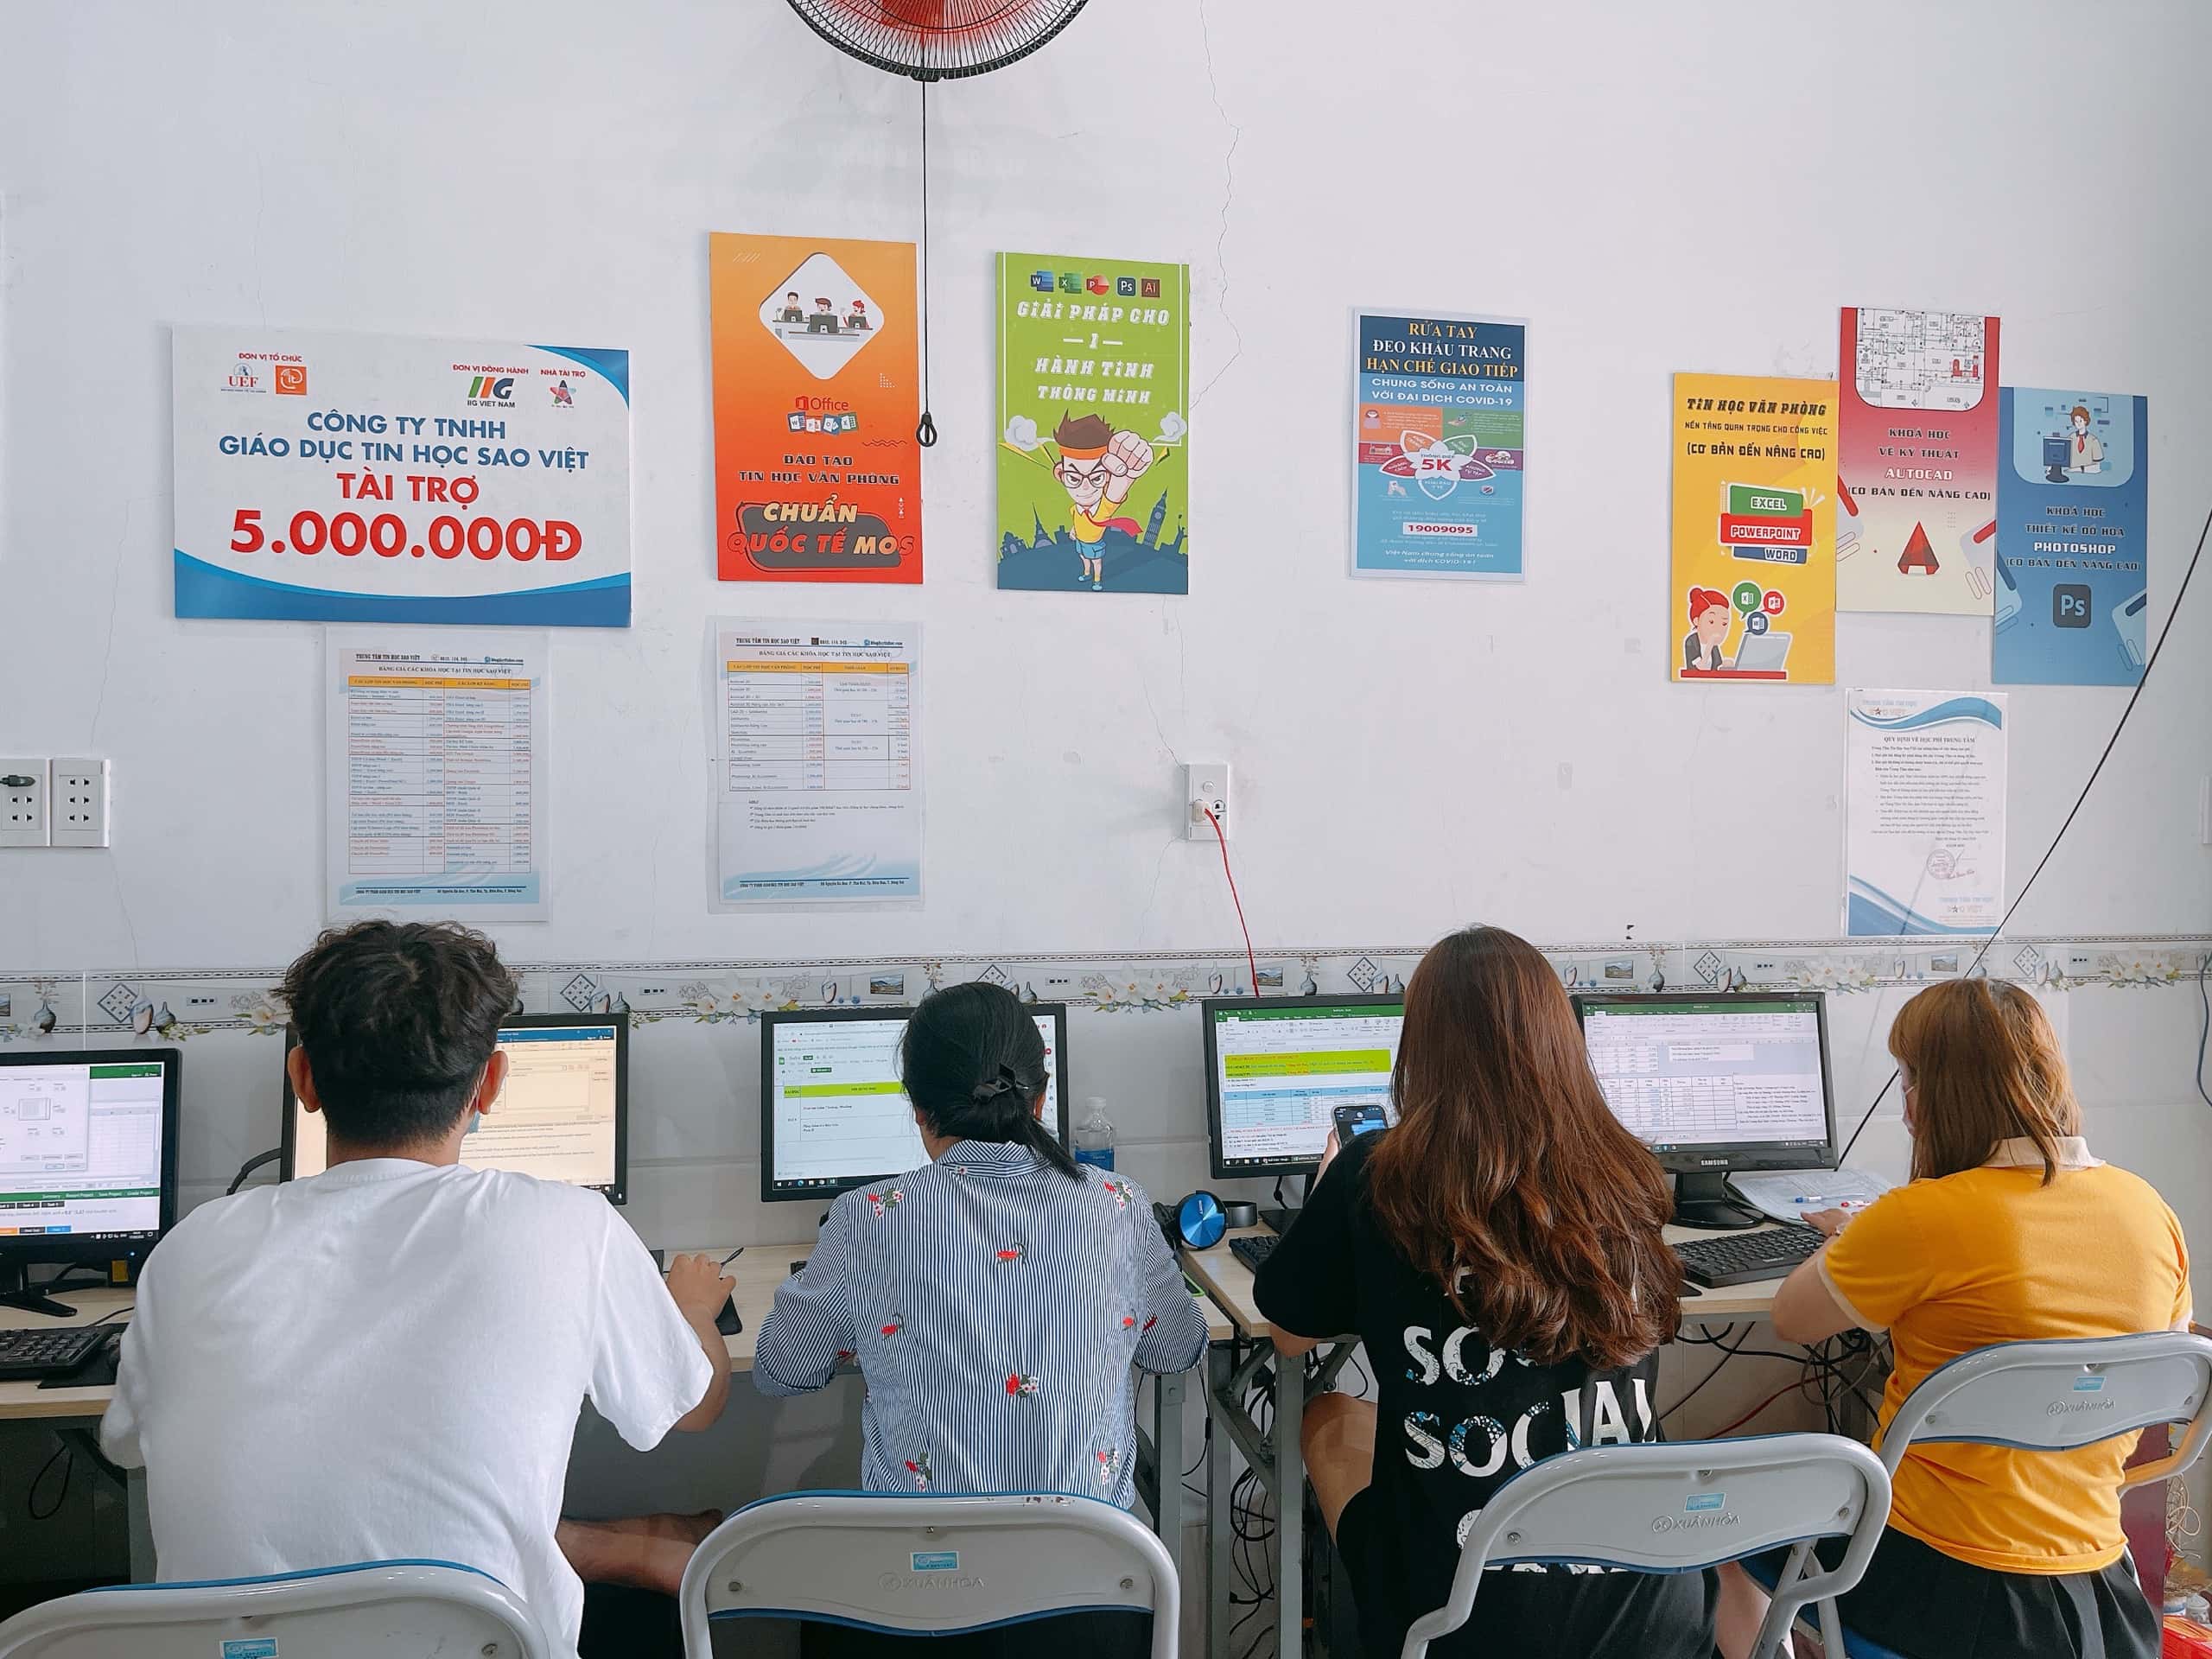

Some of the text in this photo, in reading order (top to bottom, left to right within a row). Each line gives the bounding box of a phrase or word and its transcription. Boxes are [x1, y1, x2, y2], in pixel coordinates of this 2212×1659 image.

[1121, 281, 1132, 291] Ps
[1069, 303, 1123, 322] PHÁP
[1129, 308, 1170, 326] CHO
[1446, 325, 1478, 339] TAY
[1373, 340, 1511, 359] ĐEO KHẨU TRANG
[1035, 355, 1096, 375] HÀNH
[1367, 358, 1399, 373] HẠN
[1440, 362, 1479, 375] GIAO
[229, 376, 258, 387] UEF
[1372, 378, 1417, 388] CHUNG
[1421, 379, 1455, 390] SỐNG
[1038, 384, 1097, 401] THÔNG
[1397, 393, 1418, 402] ĐẠI
[1422, 395, 1452, 404] DỊCH
[1456, 397, 1512, 406] COVID-19
[810, 397, 849, 410] Office
[1718, 400, 1745, 414] HỌC
[1749, 399, 1777, 413] VĂN
[1781, 401, 1827, 416] PHÒNG
[307, 408, 505, 438] CÔNG TY TNHH
[1812, 427, 1827, 435] VIỆC
[219, 432, 589, 474] GIÁO DỤC TIN HỌC SAO VIỆT
[1687, 442, 1825, 461] (CƠ BẢN ĐẾN NÂNG CAO)
[1421, 459, 1452, 471] 5K
[740, 472, 764, 480] TIN
[772, 473, 801, 483] HỌC
[1886, 468, 1953, 480] AUTOCAD
[336, 466, 480, 511] TÀI TRỢ
[764, 493, 857, 523] CHUẨN
[1752, 498, 1785, 509] EXCEL
[230, 509, 582, 562] 5.000.000Đ
[1408, 524, 1472, 534] 19009095
[1732, 527, 1800, 539] POWERPOINT
[728, 525, 914, 556] QUỐC TẾ MOS
[1766, 549, 1796, 560] WORD
[2034, 542, 2115, 554] PHOTOSHOP
[2061, 594, 2085, 615] Ps
